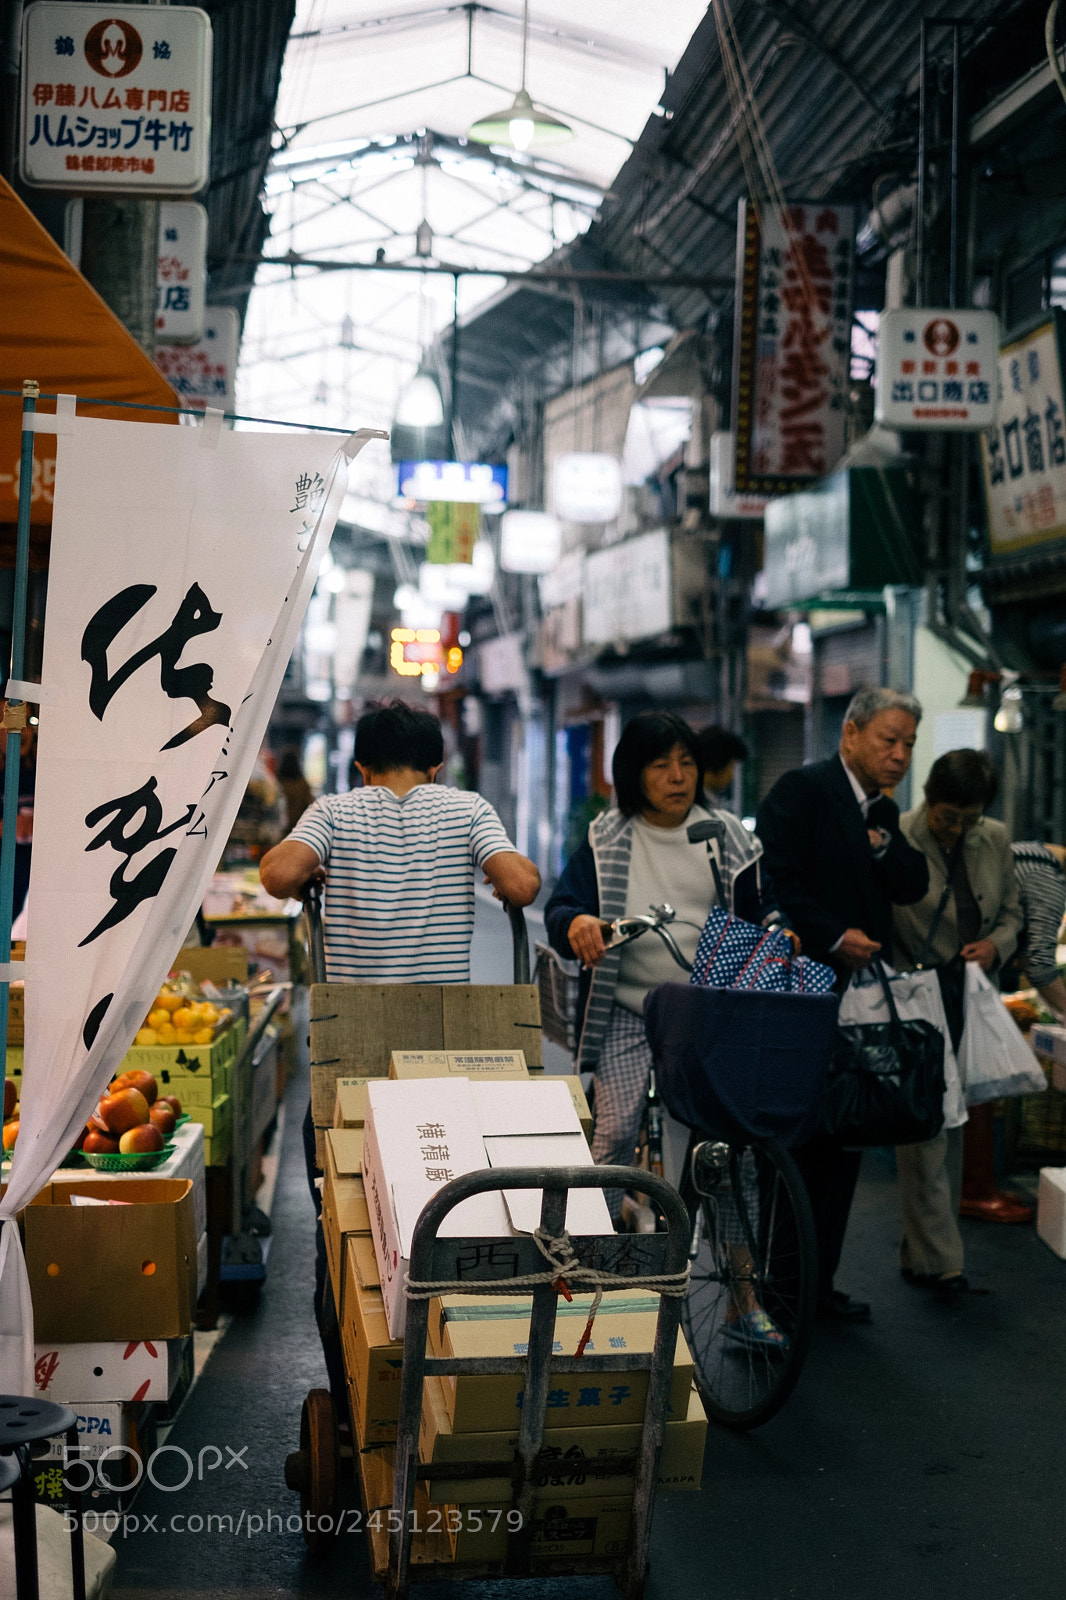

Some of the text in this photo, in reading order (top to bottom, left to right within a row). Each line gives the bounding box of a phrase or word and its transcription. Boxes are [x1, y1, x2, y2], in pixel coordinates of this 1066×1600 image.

[152, 40, 171, 60] 協
[32, 83, 190, 113] 伊藤ハム専門店
[29, 114, 194, 152] ハムショップ牛竹
[65, 155, 156, 175] 鶴橋卸売市場
